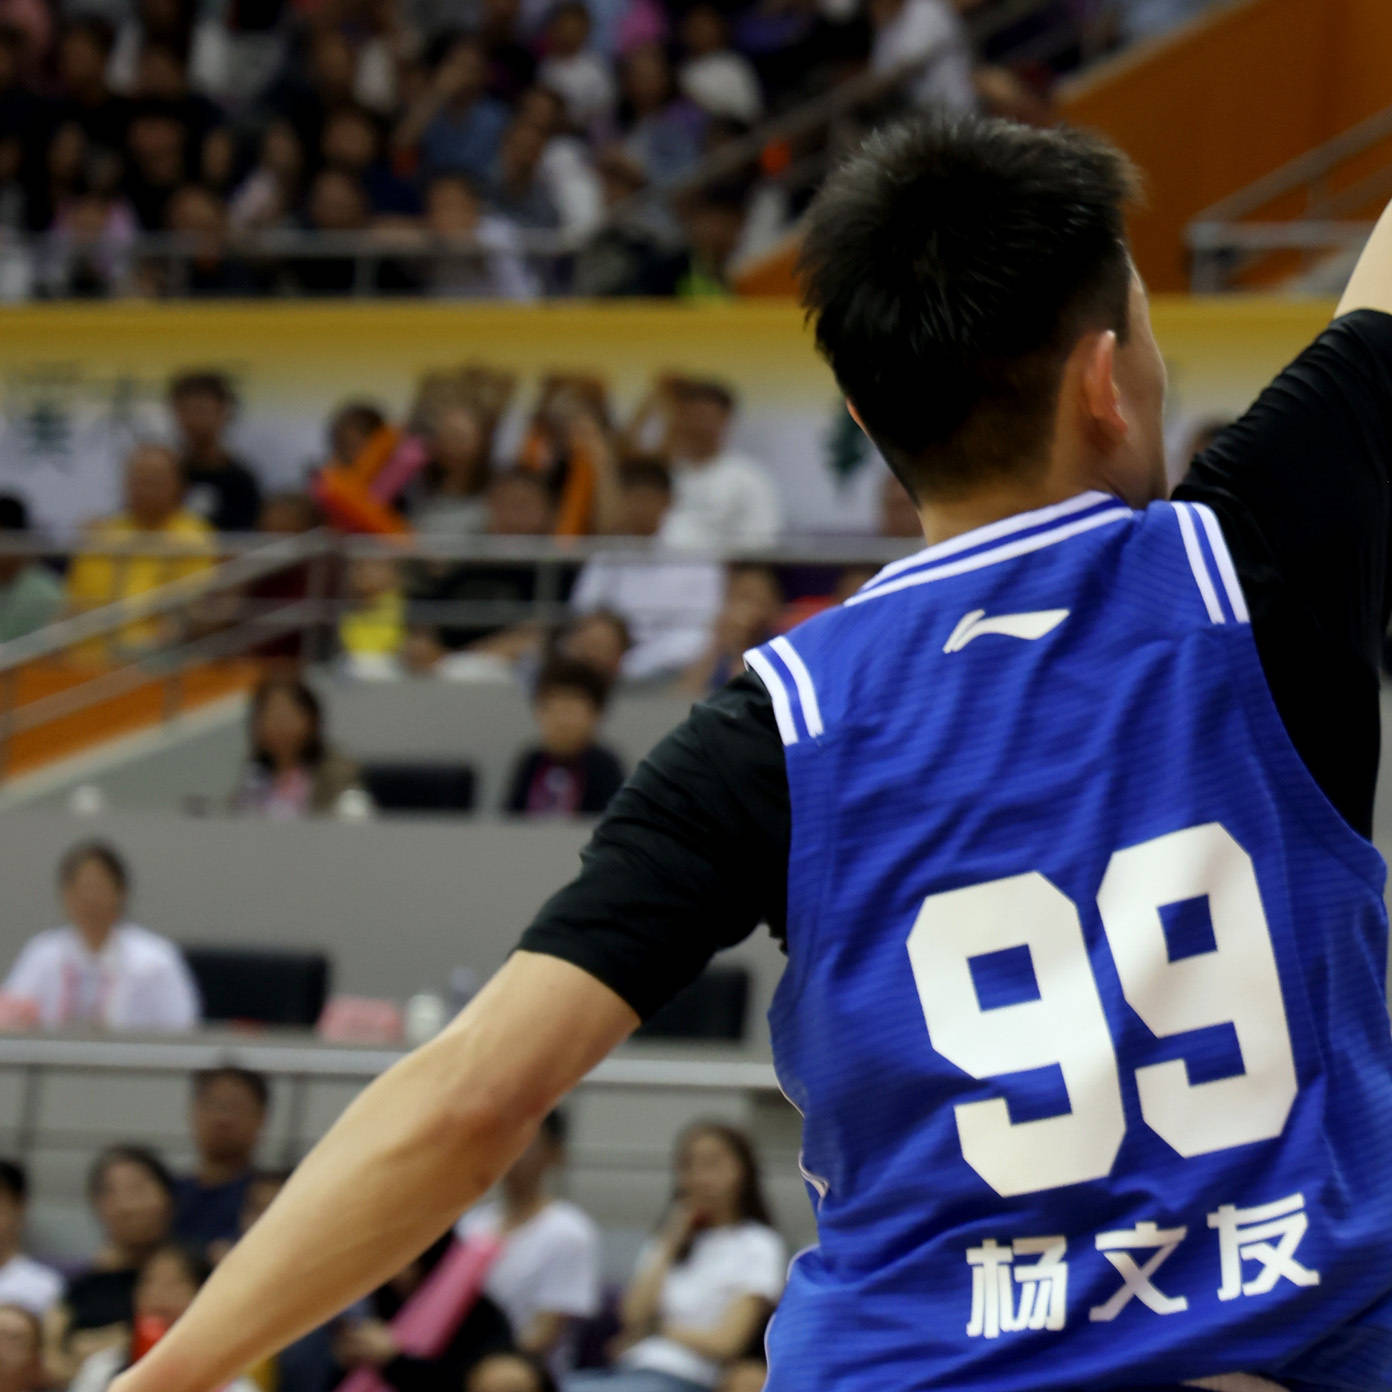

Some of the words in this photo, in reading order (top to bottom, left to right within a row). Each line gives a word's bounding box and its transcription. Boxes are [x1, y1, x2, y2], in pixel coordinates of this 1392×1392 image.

[905, 821, 1298, 1197] 99
[964, 1192, 1321, 1339] 杨文友
